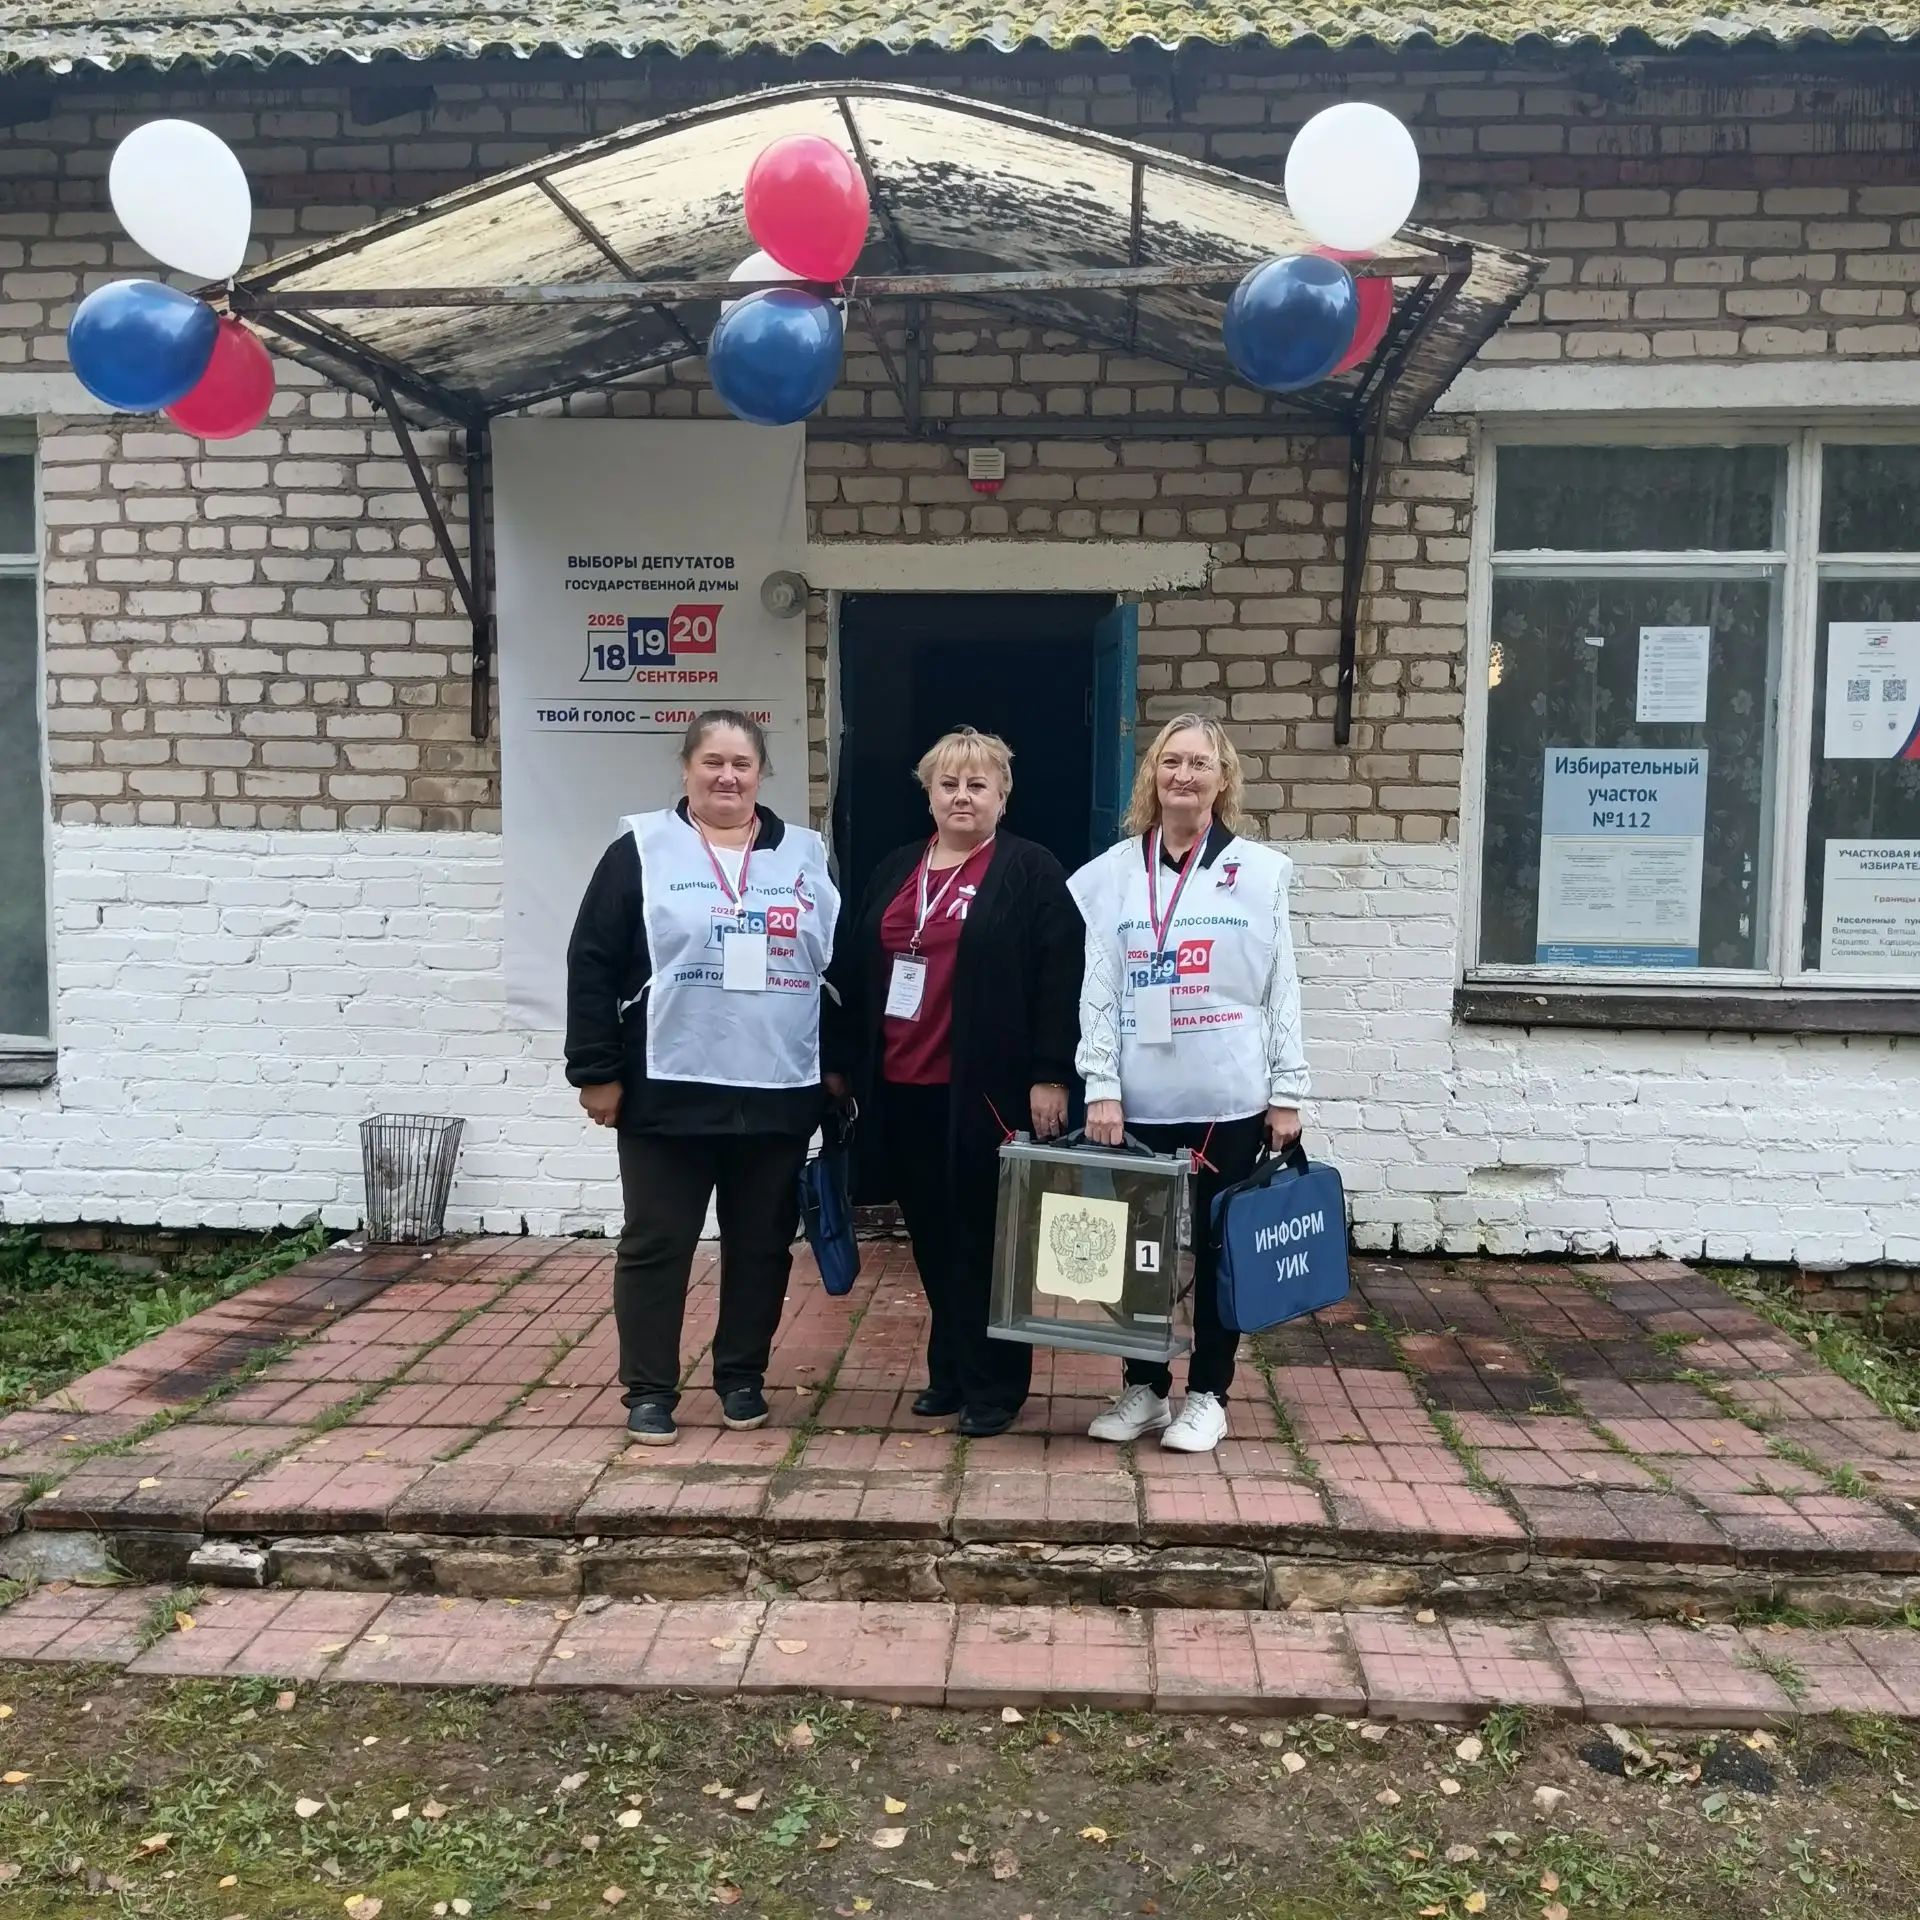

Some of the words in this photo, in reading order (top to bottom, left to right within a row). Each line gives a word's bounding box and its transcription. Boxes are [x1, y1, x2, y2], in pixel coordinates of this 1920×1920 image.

[567, 556, 637, 569] ВЫБОРЫ
[642, 556, 735, 571] ДЕПУТАТОВ
[565, 577, 695, 591] ГОСУДАРСТВЕННОЙ
[698, 579, 739, 592] ДУМЫ
[588, 614, 625, 626] 2026
[593, 644, 626, 671] 18
[632, 628, 665, 656] 19
[673, 615, 713, 643] 20
[636, 670, 718, 683] СЕНТЯБРЯ
[537, 706, 580, 722] ТВОЙ
[583, 709, 636, 722] ГОЛОС
[654, 709, 696, 722] СИЛА
[1555, 756, 1699, 779] Избирательный
[1588, 787, 1658, 806] участок
[1593, 811, 1651, 828] №112
[1839, 849, 1910, 858] УЧАСТКОВАЯ
[1860, 862, 1920, 870] ИЗБИРАТЕ
[670, 881, 718, 892] ЕДИНЫЙ
[768, 912, 795, 930] 20
[1136, 920, 1151, 930] ДЕ
[1174, 916, 1249, 928] ОЛОСОВАНИЯ
[768, 946, 795, 958] ЯБРЯ
[1127, 950, 1149, 959] 2026
[1130, 970, 1149, 988] 18
[1179, 946, 1207, 967] 20
[673, 969, 703, 982] ТВОЙ
[767, 977, 781, 986] ЛА
[1171, 985, 1210, 996] ТЯБРЯ
[1172, 1016, 1197, 1027] ИЛА
[1254, 1210, 1325, 1253] ИНФОРМ
[1141, 1245, 1155, 1268] 1
[1276, 1251, 1311, 1283] УИК
